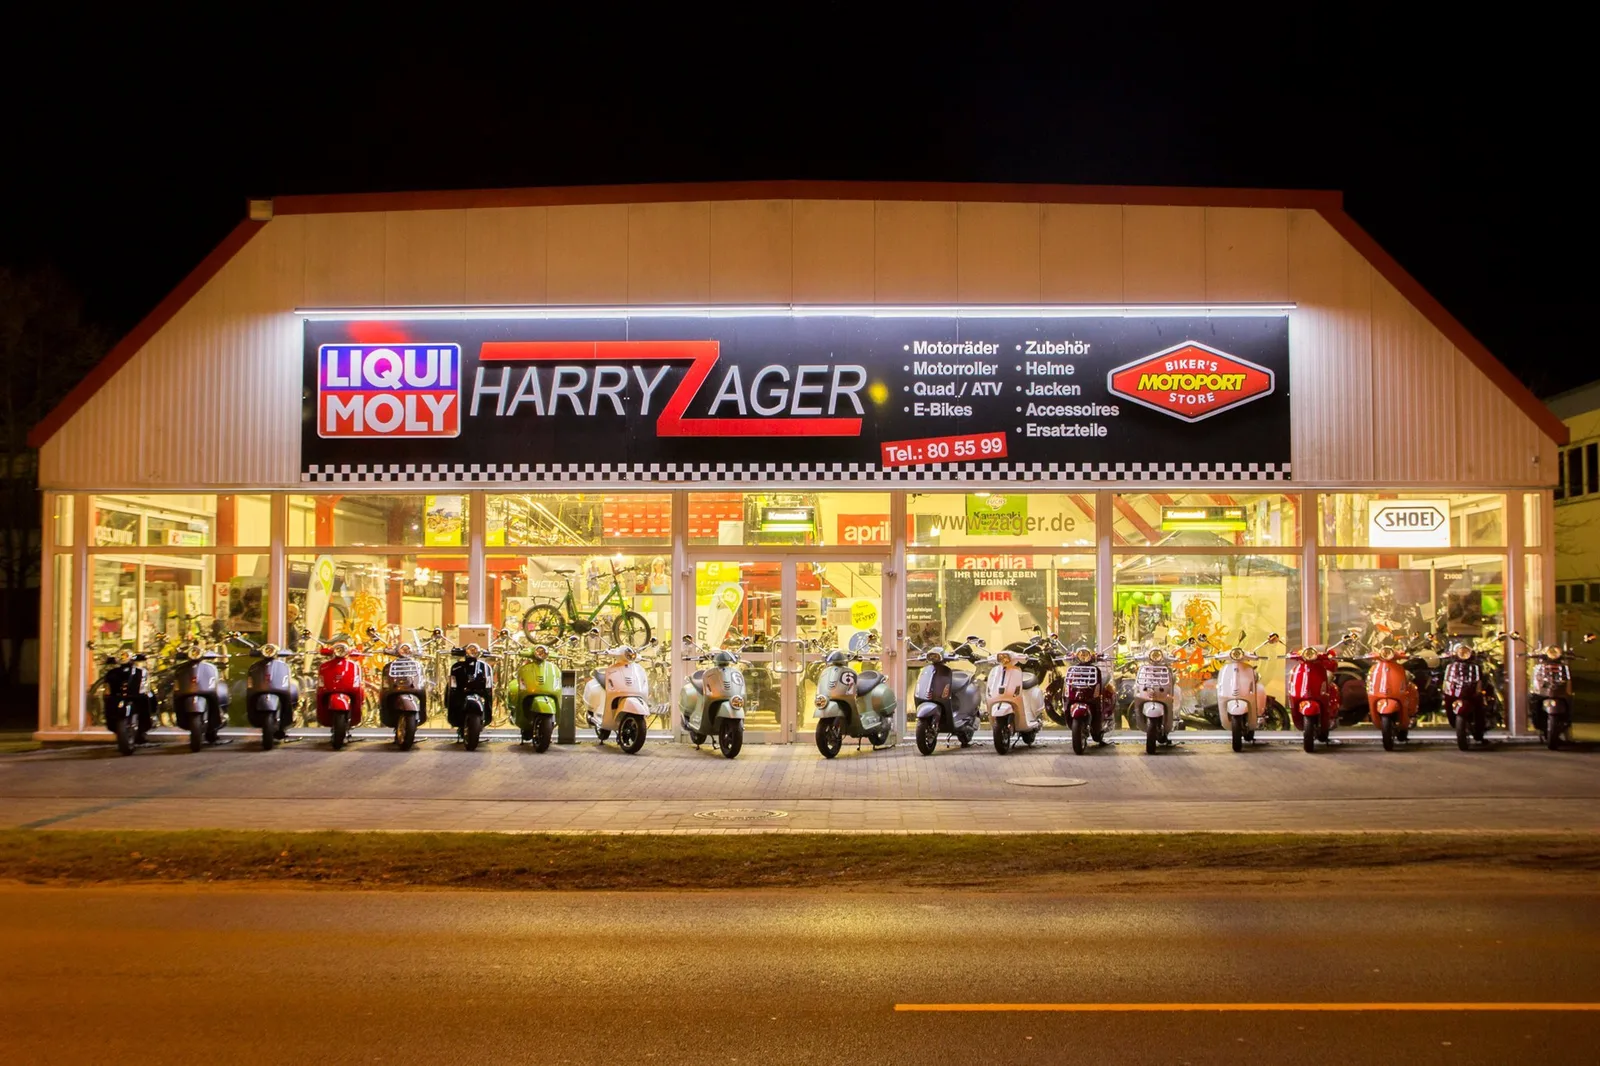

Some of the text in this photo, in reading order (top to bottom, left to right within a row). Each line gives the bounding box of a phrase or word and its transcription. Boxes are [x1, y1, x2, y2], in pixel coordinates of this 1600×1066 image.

[913, 340, 999, 355] Motorräder
[1025, 340, 1091, 355] Zubehör
[326, 348, 452, 389] LIQUI
[913, 361, 998, 375] Motorroller
[1025, 361, 1075, 375] Helme
[1164, 359, 1218, 372] BIKER'S
[913, 382, 955, 397] Quad
[971, 381, 1003, 396] ATV
[1025, 381, 1081, 396] Jacken
[1137, 373, 1246, 391] MOTOPORT
[469, 365, 672, 416] HARRY
[1168, 392, 1215, 405] STORE
[325, 393, 456, 433] MOLY
[913, 403, 972, 417] E-Bikes
[1025, 403, 1120, 417] Accessoires
[1026, 423, 1107, 437] Ersatzteile
[885, 437, 1003, 463] Tel.: 80 55 99
[932, 512, 1076, 536] www.zager.de
[1384, 511, 1435, 527] SHOEI
[963, 555, 1027, 569] aprilia
[954, 571, 1037, 579] IHR NEUES LEBEN
[978, 591, 1012, 601] HIER
